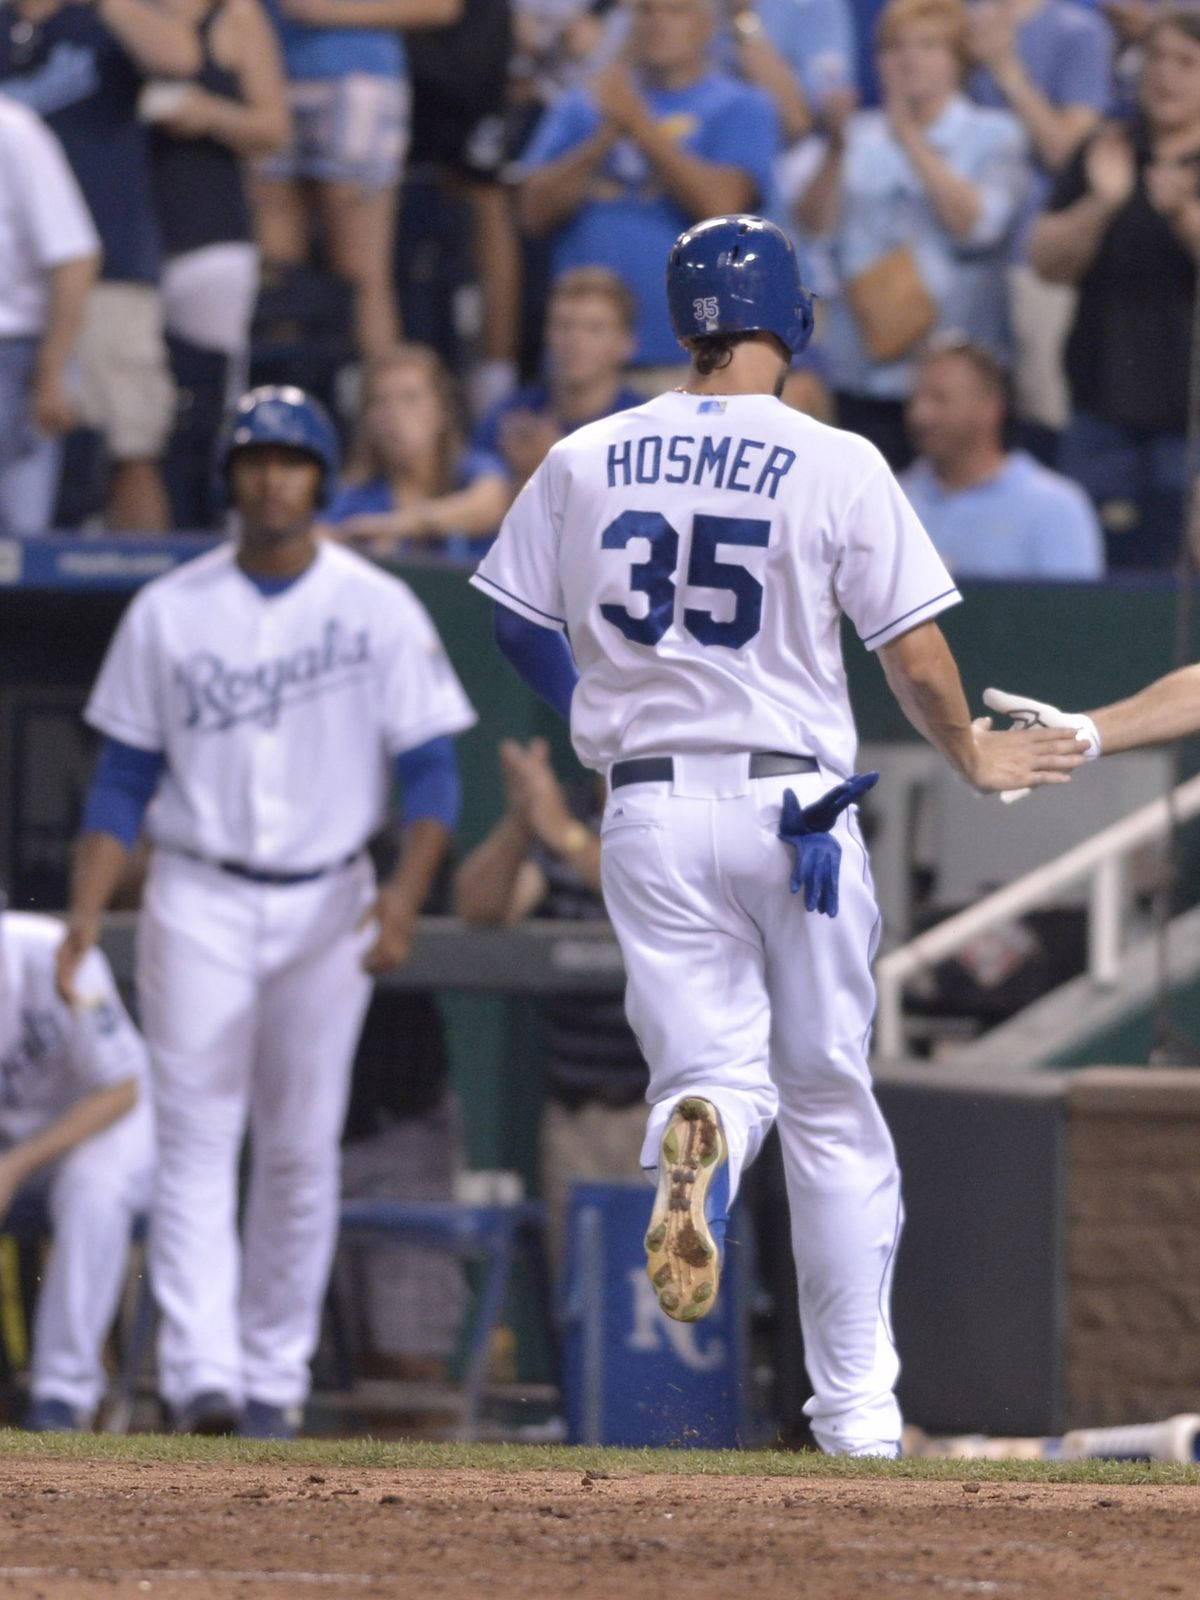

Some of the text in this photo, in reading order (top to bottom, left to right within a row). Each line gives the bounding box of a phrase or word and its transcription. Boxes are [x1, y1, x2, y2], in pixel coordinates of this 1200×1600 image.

[692, 297, 719, 320] 35
[607, 435, 796, 499] HOSMER
[600, 510, 771, 649] 35
[175, 618, 369, 733] Royals
